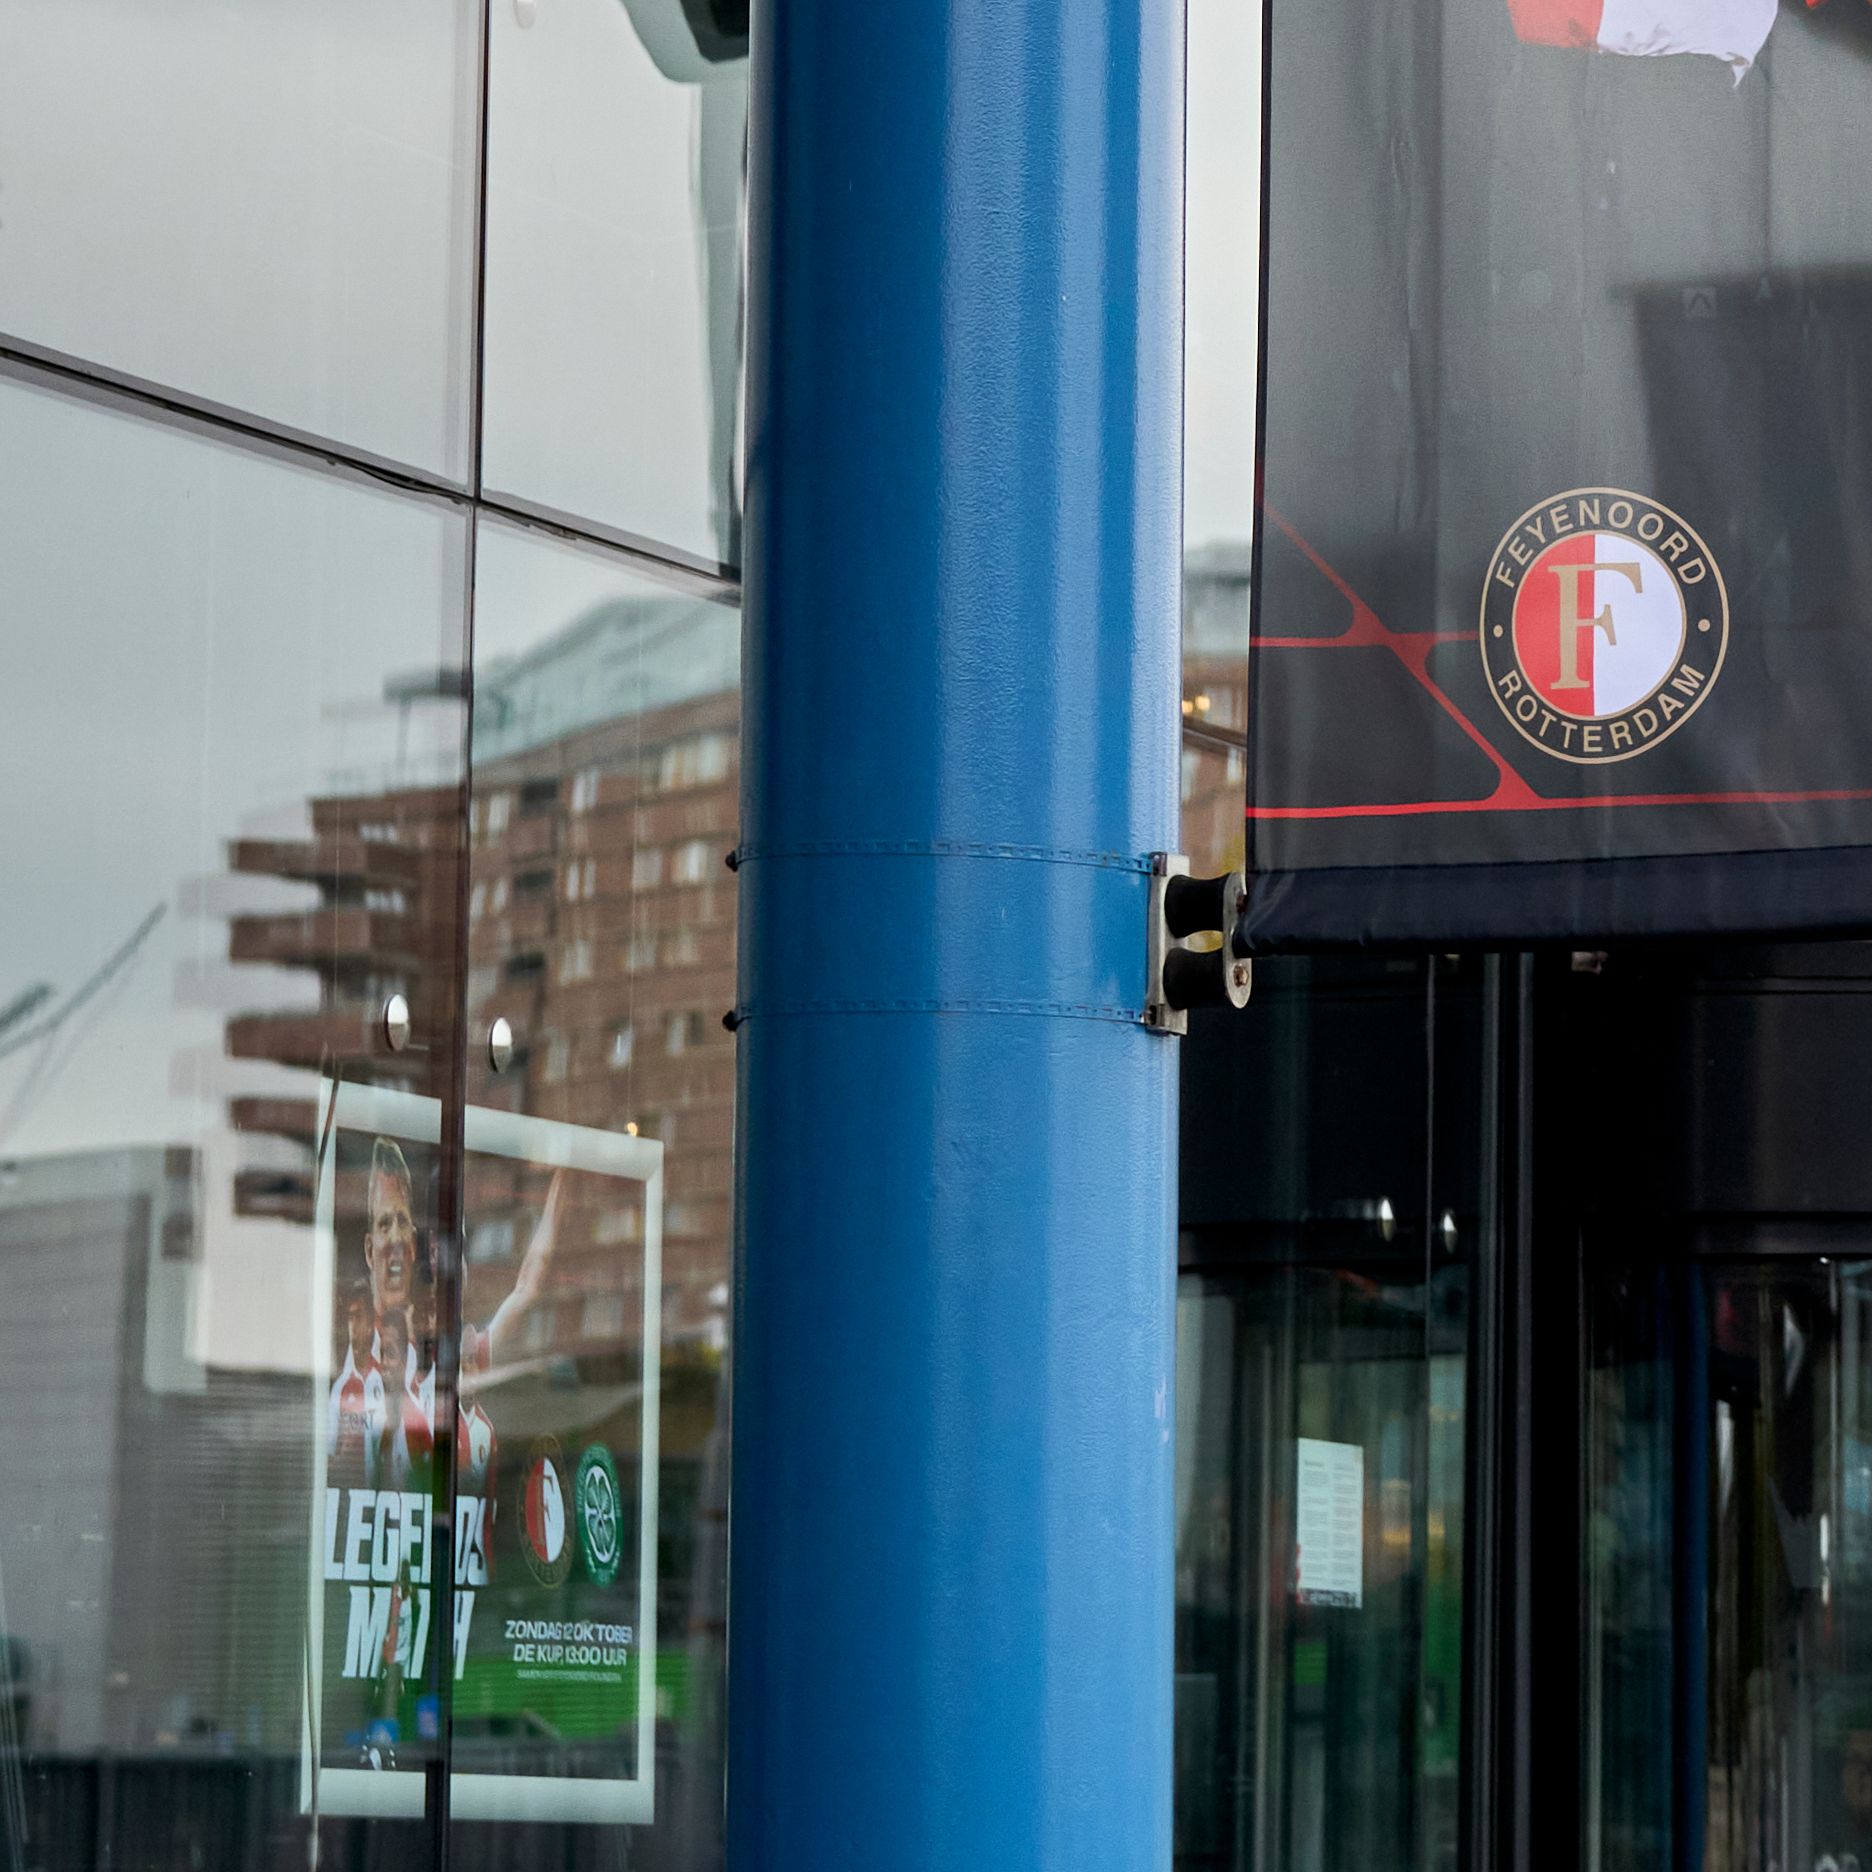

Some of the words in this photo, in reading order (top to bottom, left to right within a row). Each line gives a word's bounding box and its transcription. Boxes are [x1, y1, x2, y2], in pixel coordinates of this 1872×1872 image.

[1495, 498, 1707, 589] FEYENOORD
[1547, 561, 1643, 691] F
[1498, 663, 1705, 753] ROTTERDAM
[504, 1620, 560, 1640] ZONDAG
[513, 1643, 535, 1662] DE
